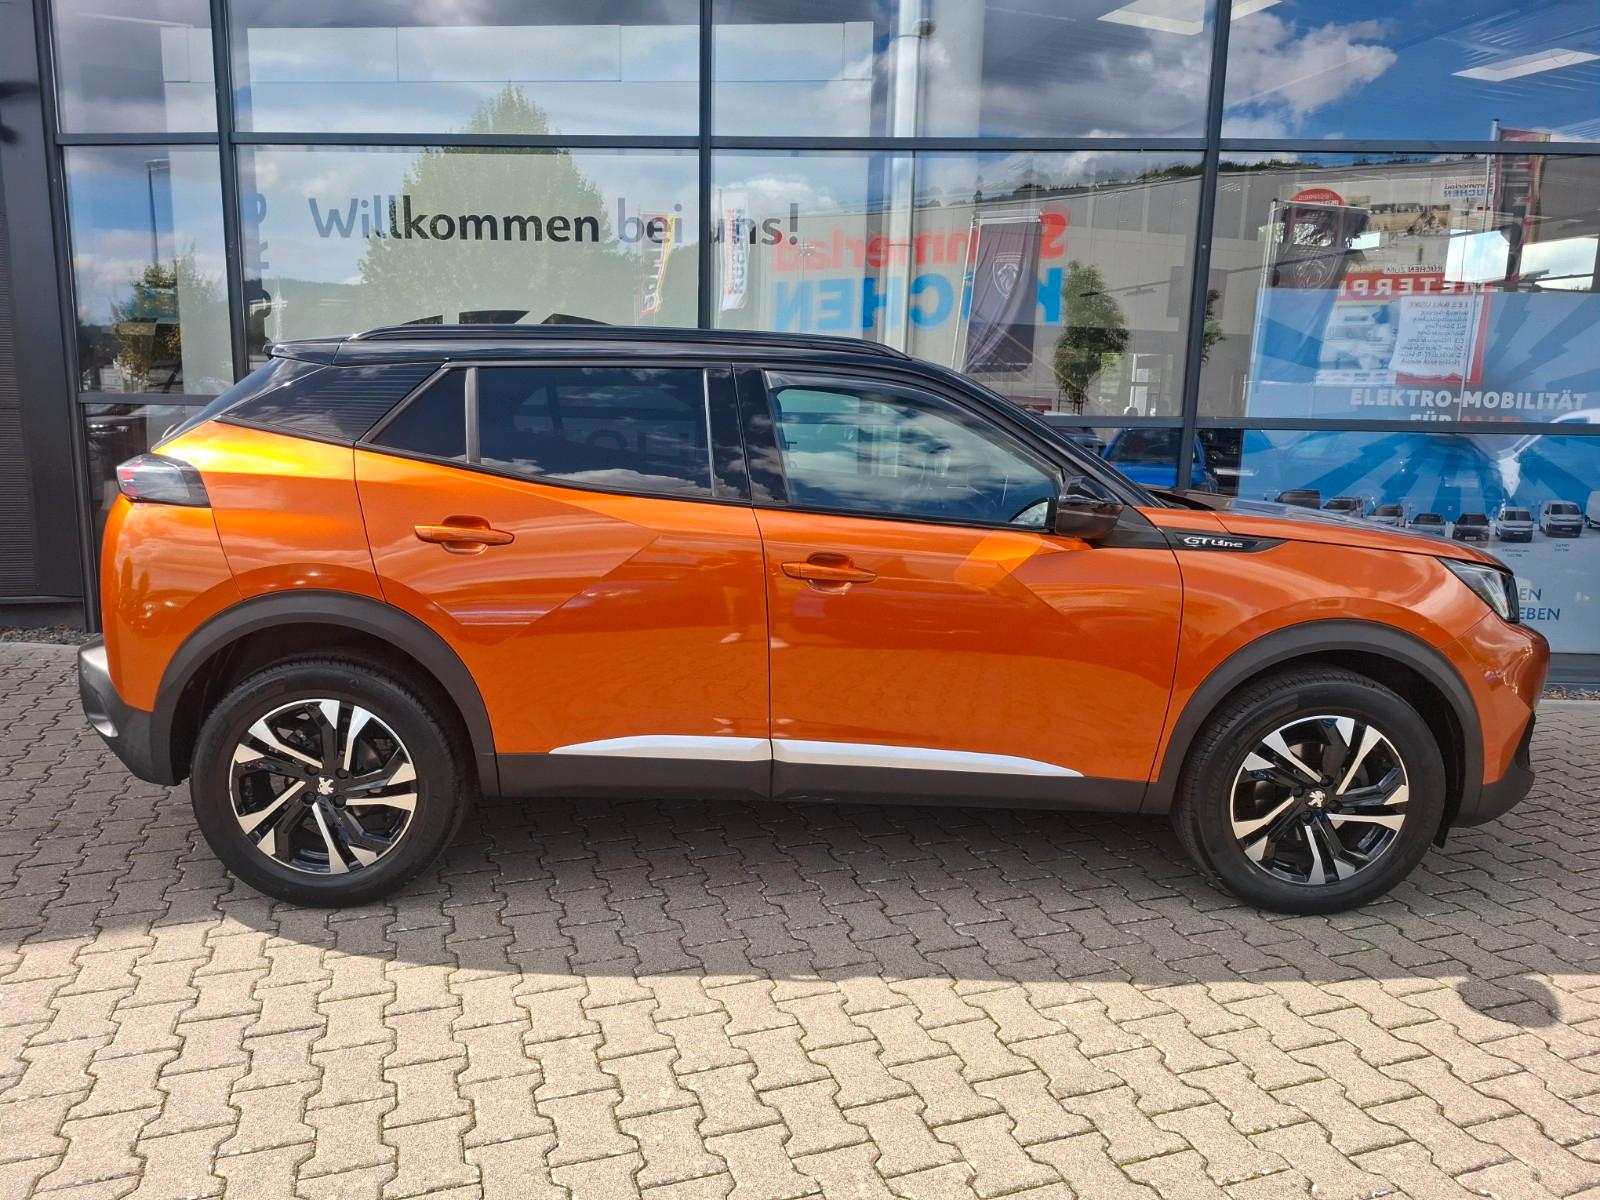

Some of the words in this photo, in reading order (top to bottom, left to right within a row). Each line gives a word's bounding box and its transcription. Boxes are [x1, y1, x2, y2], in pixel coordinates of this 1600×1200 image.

[308, 195, 600, 242] Willkommen
[617, 198, 683, 244] bei
[1350, 388, 1587, 410] ELEKTRO-MOBILITÄT
[1520, 588, 1542, 601] EN
[1519, 607, 1561, 621] EBEN
